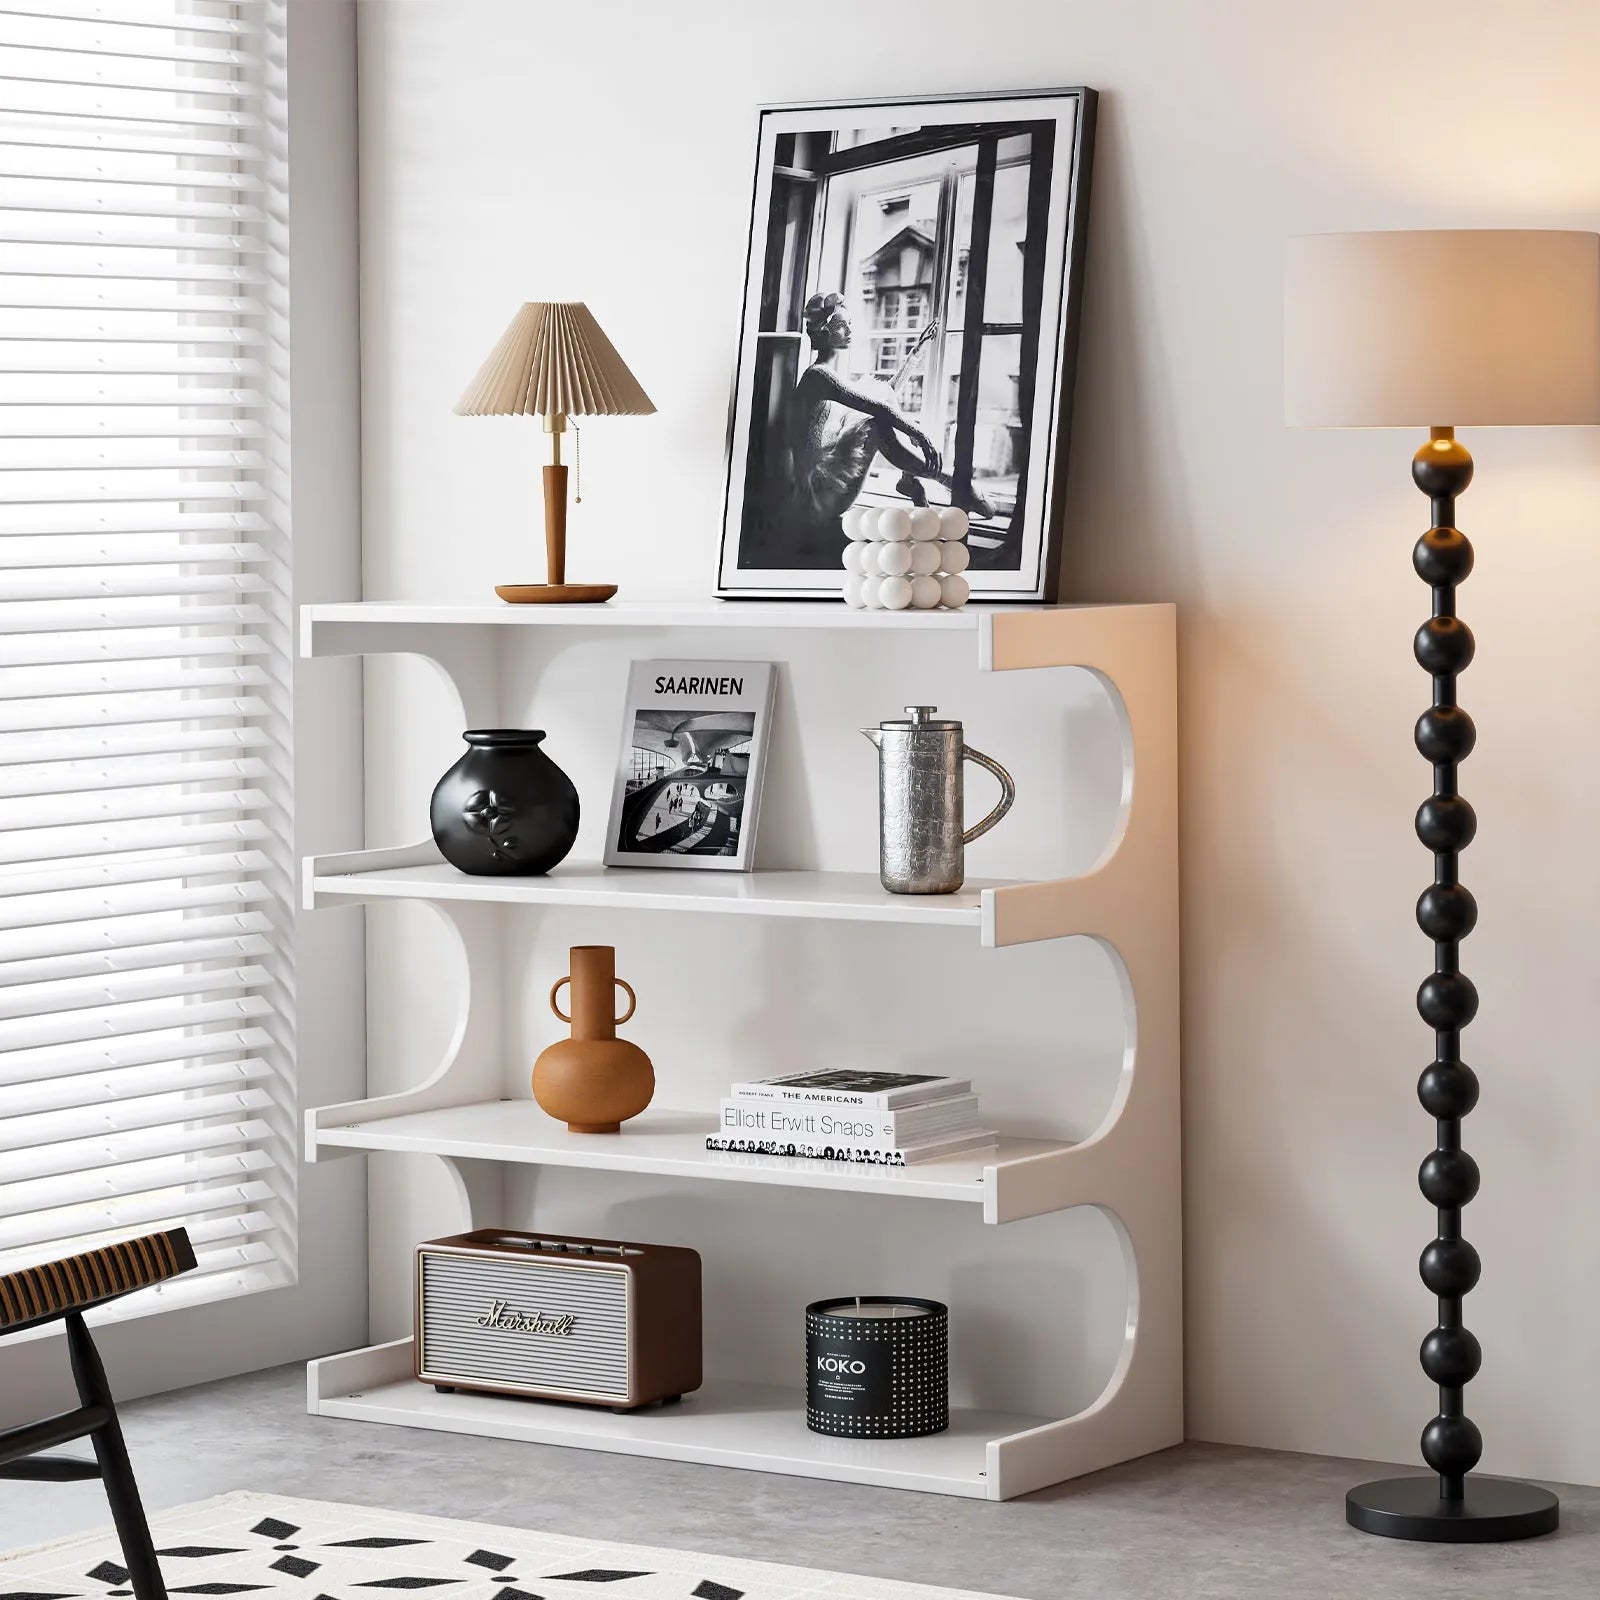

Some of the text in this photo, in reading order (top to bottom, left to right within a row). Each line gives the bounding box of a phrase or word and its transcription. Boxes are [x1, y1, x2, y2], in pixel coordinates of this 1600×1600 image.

[654, 676, 744, 696] SAARINEN
[782, 1091, 864, 1105] THE AMERICANS
[725, 1107, 874, 1140] Elliott Erwitt Snaps
[476, 1300, 575, 1336] Marshall
[817, 1356, 866, 1374] KOKO
